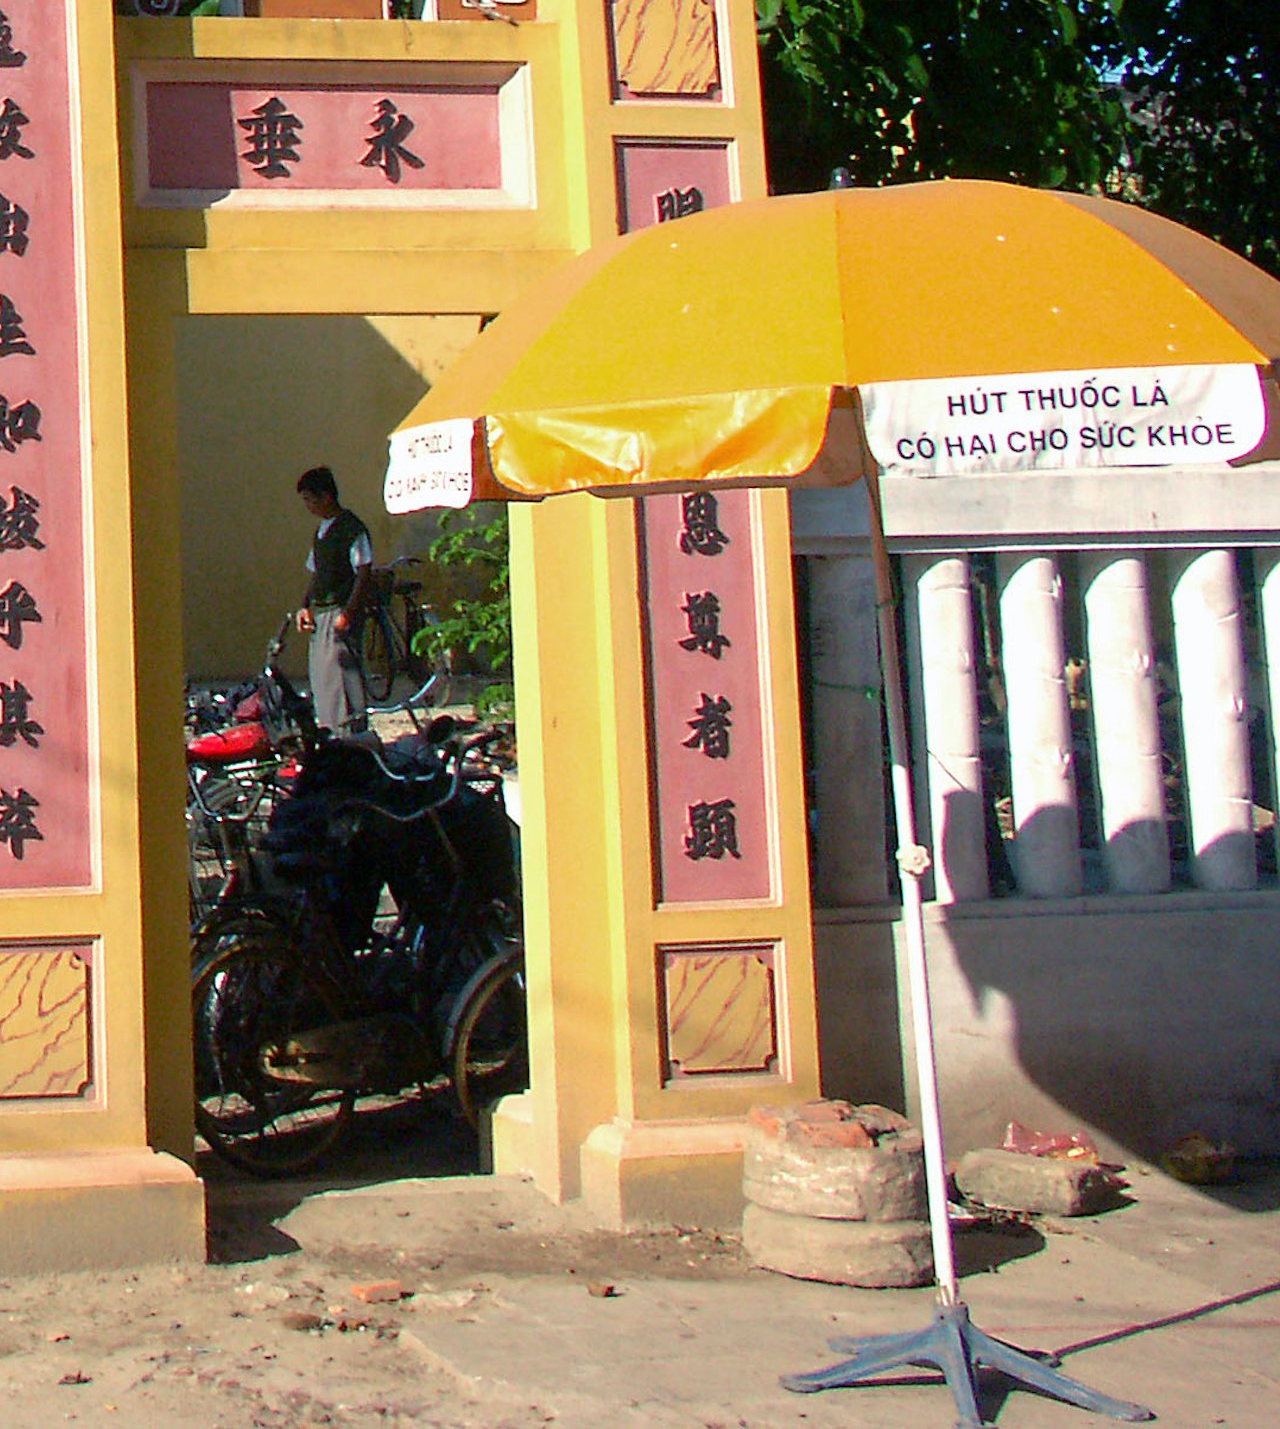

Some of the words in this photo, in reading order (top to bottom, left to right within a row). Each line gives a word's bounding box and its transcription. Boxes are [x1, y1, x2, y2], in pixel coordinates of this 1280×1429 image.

[947, 387, 1008, 417] HÚT
[1018, 377, 1121, 412] THUỐC
[896, 431, 936, 460] CÓ
[944, 433, 997, 460] HẠI
[1007, 428, 1069, 454] CHO
[1079, 420, 1136, 449] SỨC
[1147, 415, 1236, 447] KHỎE
